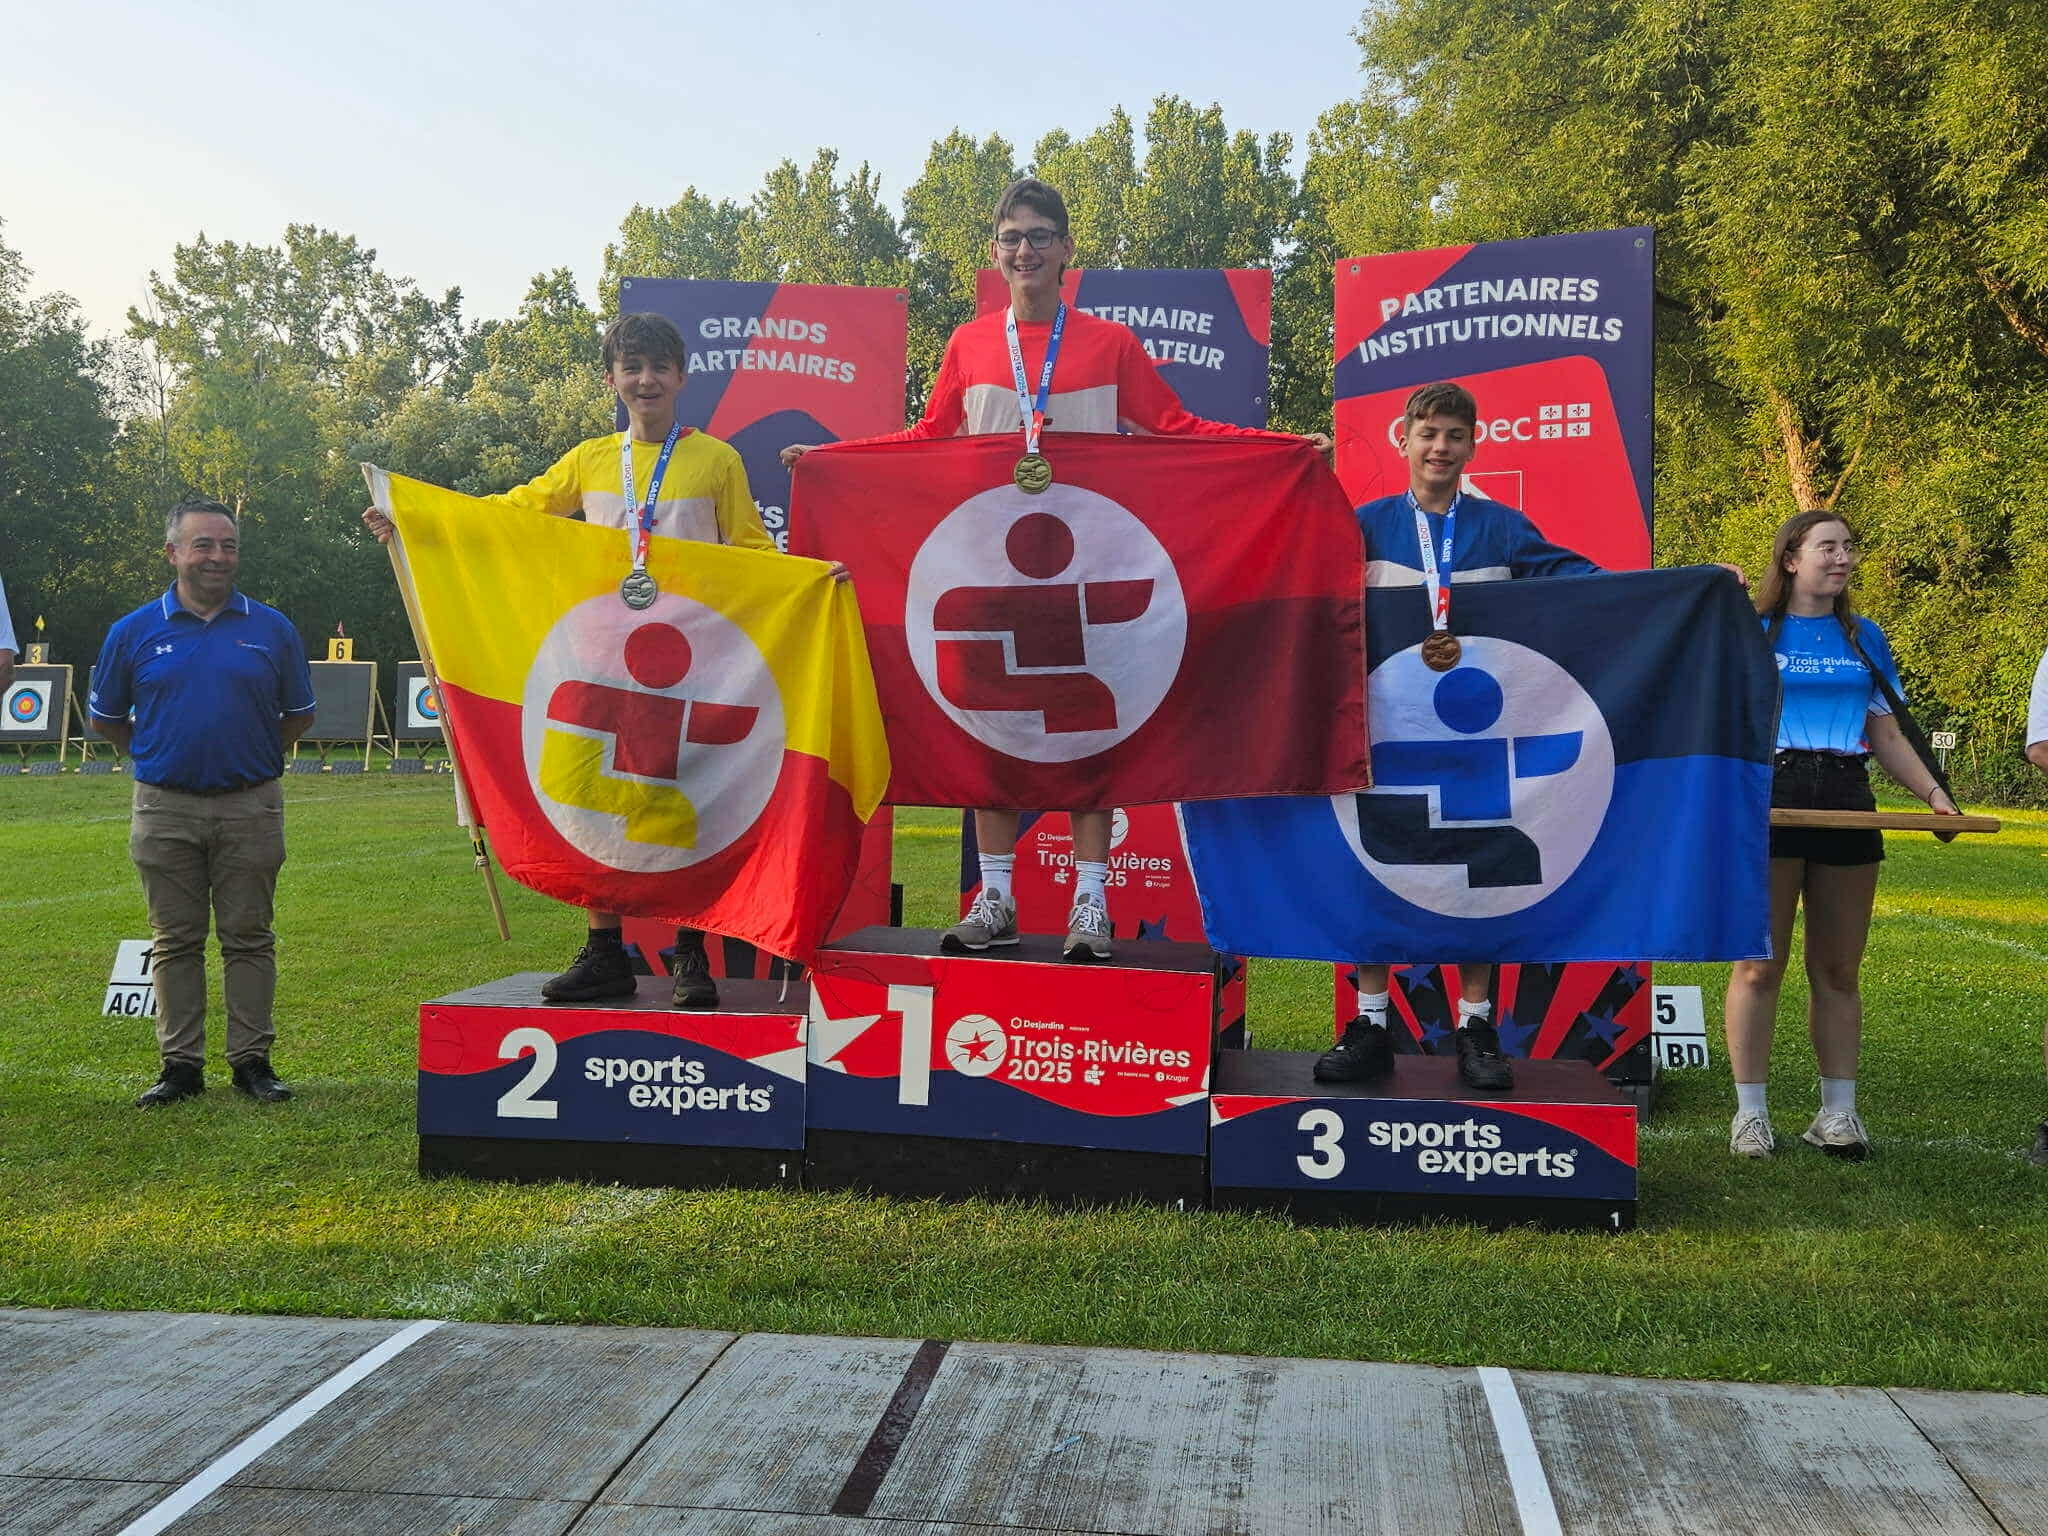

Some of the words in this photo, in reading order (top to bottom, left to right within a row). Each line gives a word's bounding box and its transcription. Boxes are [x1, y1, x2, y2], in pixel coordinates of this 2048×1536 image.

[1380, 277, 1600, 322] PARTENAIRES
[699, 317, 828, 345] GRANDS
[1078, 306, 1214, 335] TENAIRE
[1359, 313, 1624, 364] INSTITUTIONNELS
[687, 349, 857, 384] ARTENAIRES
[1442, 538, 1453, 563] OASIS
[31, 645, 42, 664] 3
[335, 641, 345, 660] 6
[1788, 665, 1820, 674] 2025
[1934, 733, 1954, 747] 30
[1023, 1019, 1065, 1031] Desjardins
[887, 984, 935, 1106] 1
[1666, 1043, 1705, 1068] BD
[497, 1027, 558, 1120] 2
[584, 1055, 706, 1088] sports
[1007, 1058, 1073, 1084] 2025
[1165, 1073, 1190, 1083] Kruger
[1296, 1108, 1345, 1180] 3
[1367, 1117, 1502, 1153] sports
[779, 1163, 787, 1179] 1
[1610, 1211, 1619, 1228] 1
